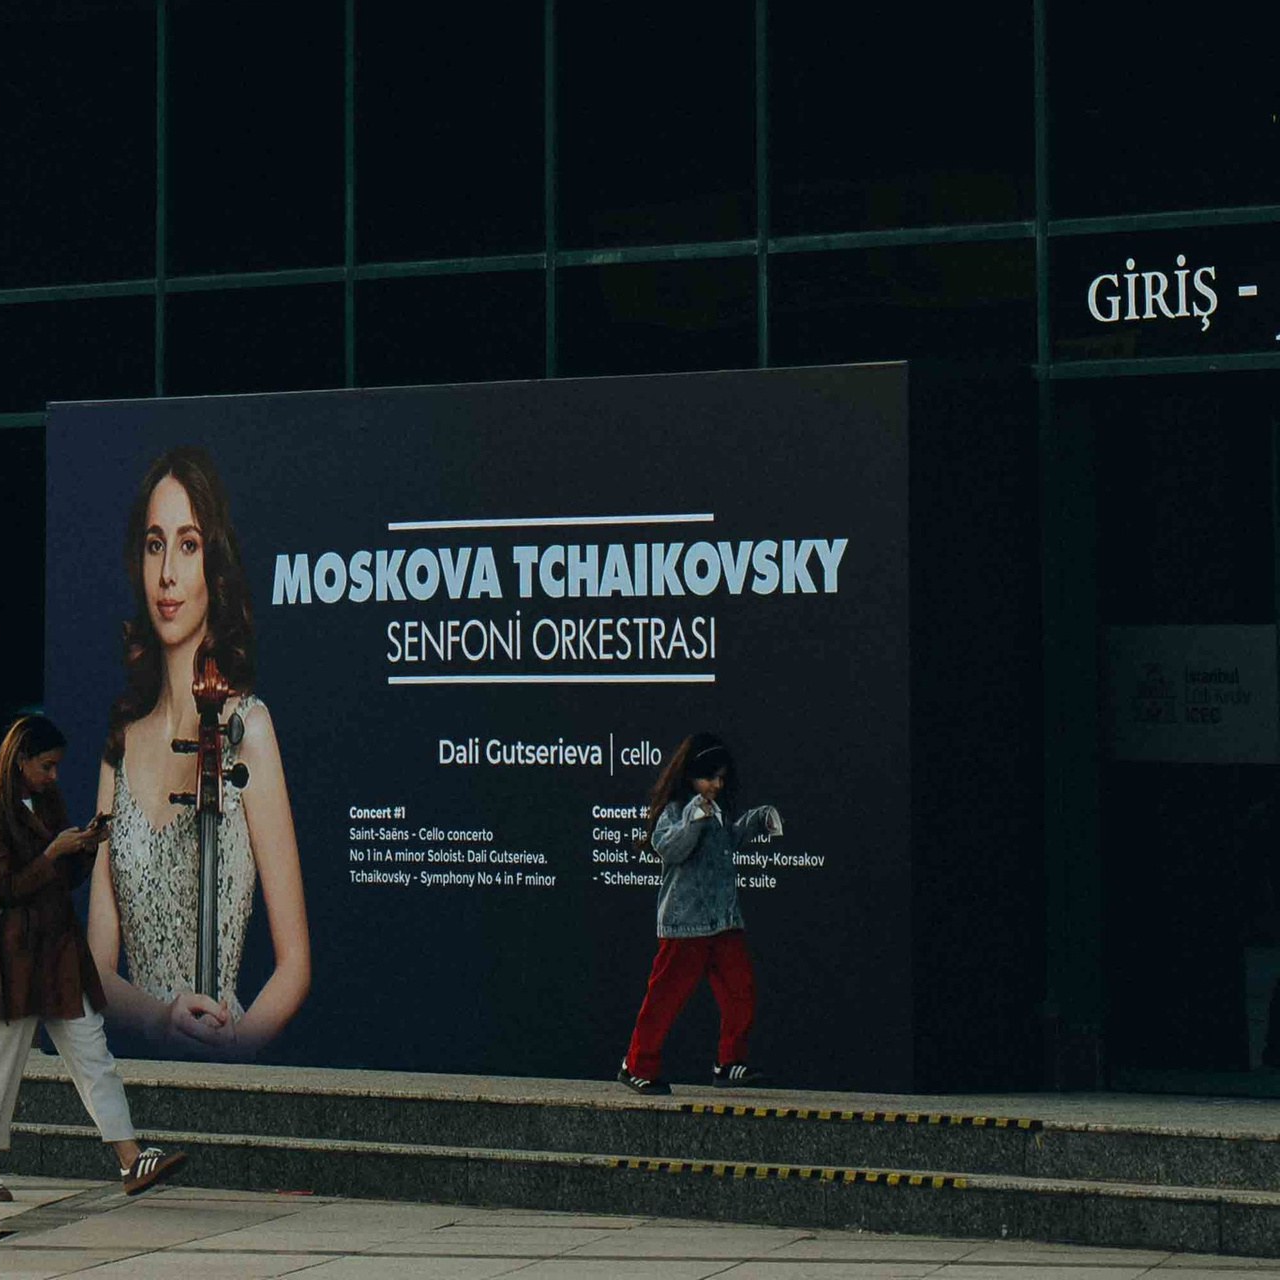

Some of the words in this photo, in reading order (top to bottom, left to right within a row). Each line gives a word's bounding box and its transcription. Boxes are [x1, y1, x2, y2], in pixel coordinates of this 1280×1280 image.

[1087, 254, 1218, 332] GİRİŞ
[271, 546, 503, 605] MOSKOVA
[513, 538, 849, 599] TCHAIKOVSKY
[386, 610, 521, 663] SENFONİ
[532, 616, 716, 661] ORKESTRASI
[439, 737, 480, 765] Dali
[485, 737, 603, 765] Gutserieva
[620, 740, 662, 766] cello
[349, 806, 392, 819] Concert
[393, 806, 406, 819] #1
[591, 805, 638, 819] Concert
[418, 826, 445, 841] Cello
[446, 828, 494, 842] concerto
[592, 826, 621, 845] Grieg
[349, 848, 365, 862] No
[366, 848, 371, 862] 1
[373, 848, 383, 862] in
[384, 848, 393, 862] A
[394, 848, 426, 863] minor
[427, 848, 465, 863] Soloist:
[467, 849, 487, 864] Dali
[488, 849, 548, 864] Gutserieva.
[592, 848, 629, 864] Soloist
[349, 869, 411, 887] Tchaikovsky
[420, 870, 476, 888] Symphony
[477, 871, 494, 885] No
[494, 871, 502, 885] 4
[503, 870, 514, 885] in
[516, 872, 523, 886] F
[524, 871, 557, 887] minor
[748, 873, 777, 889] suite
